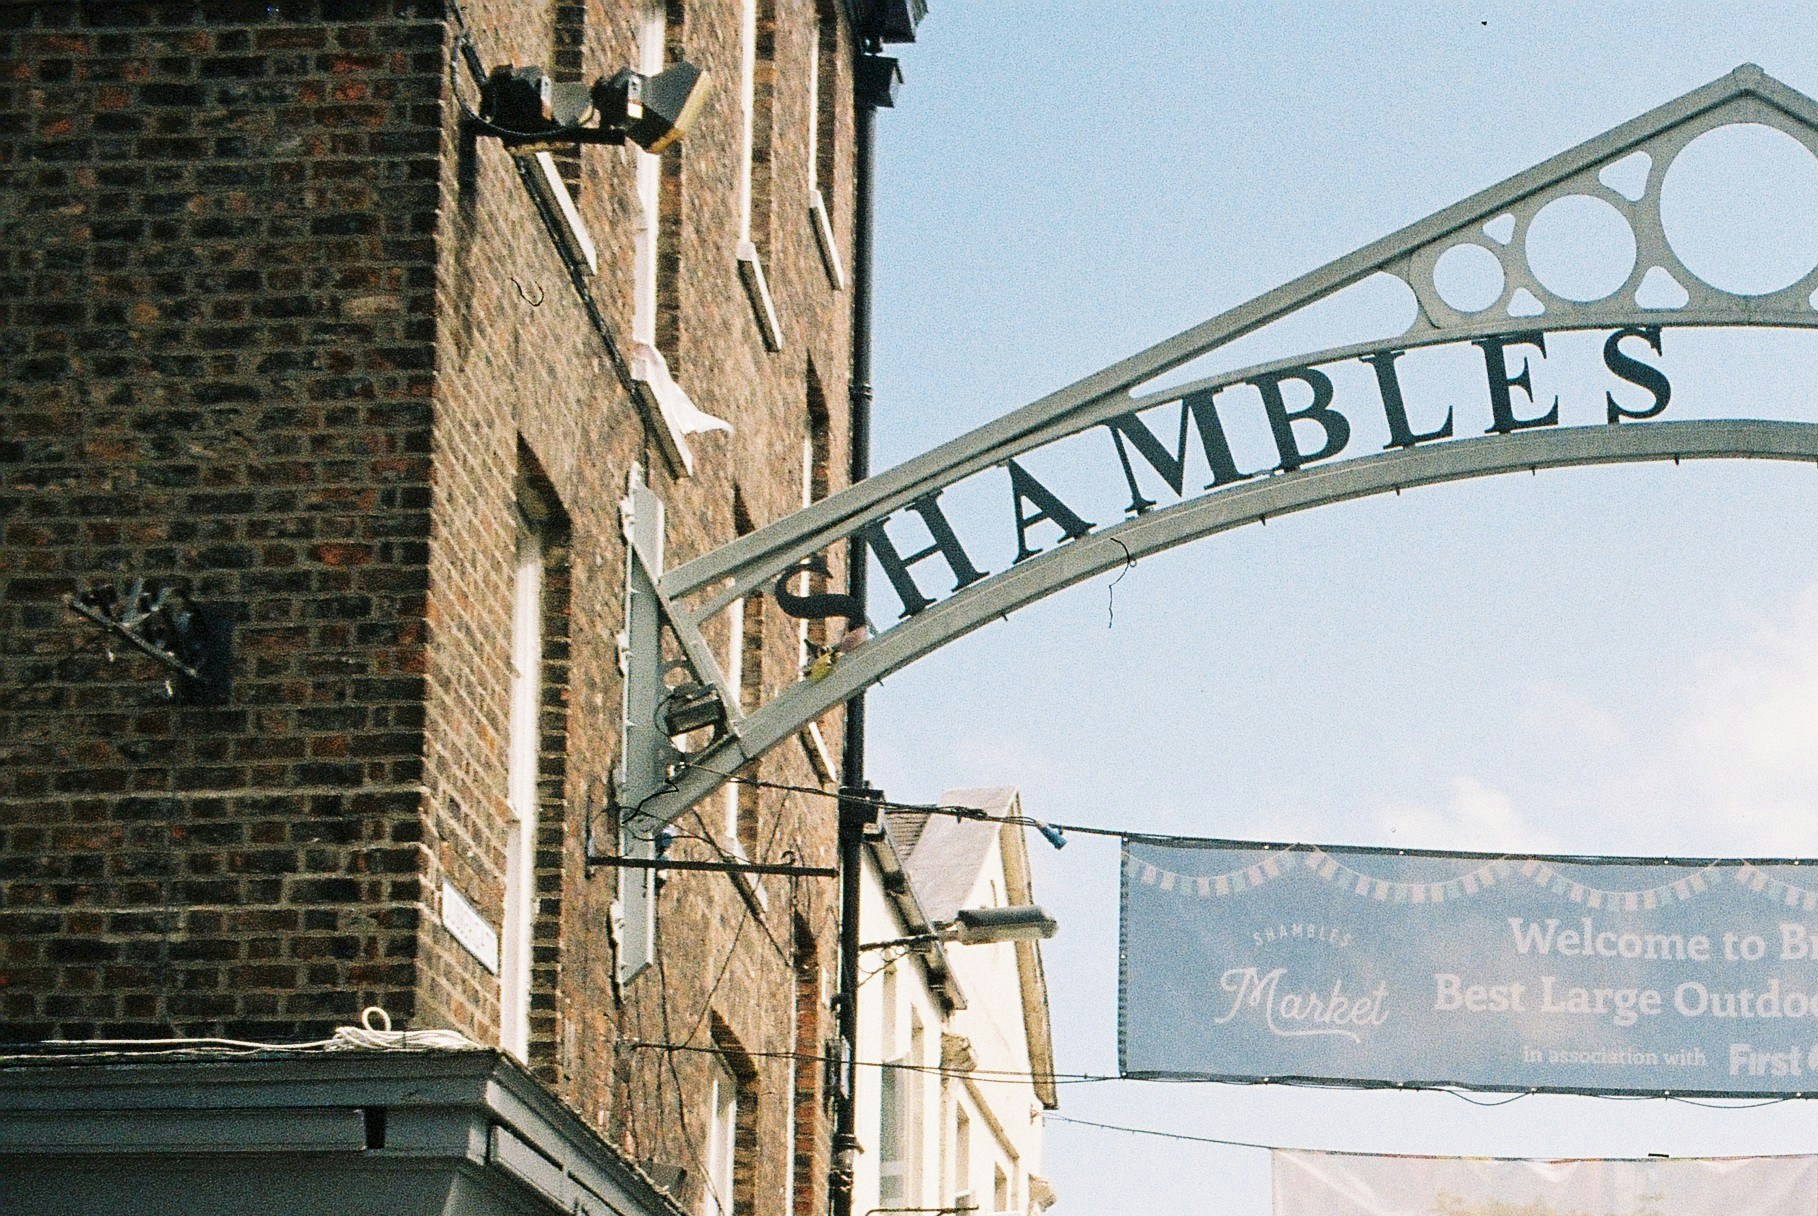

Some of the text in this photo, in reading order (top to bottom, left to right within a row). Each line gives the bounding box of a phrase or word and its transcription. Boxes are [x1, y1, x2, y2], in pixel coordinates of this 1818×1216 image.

[774, 326, 1672, 638] SHAMBLES
[1253, 922, 1353, 948] SHAMBLES
[1508, 917, 1712, 961] Welcome
[1722, 929, 1766, 961] to
[1214, 966, 1390, 1043] Market
[1433, 972, 1526, 1013] Best
[1540, 975, 1663, 1027] Large
[1523, 1045, 1544, 1064] in
[1548, 1046, 1658, 1066] association
[1662, 1046, 1706, 1067] with
[1729, 1043, 1802, 1077] First
